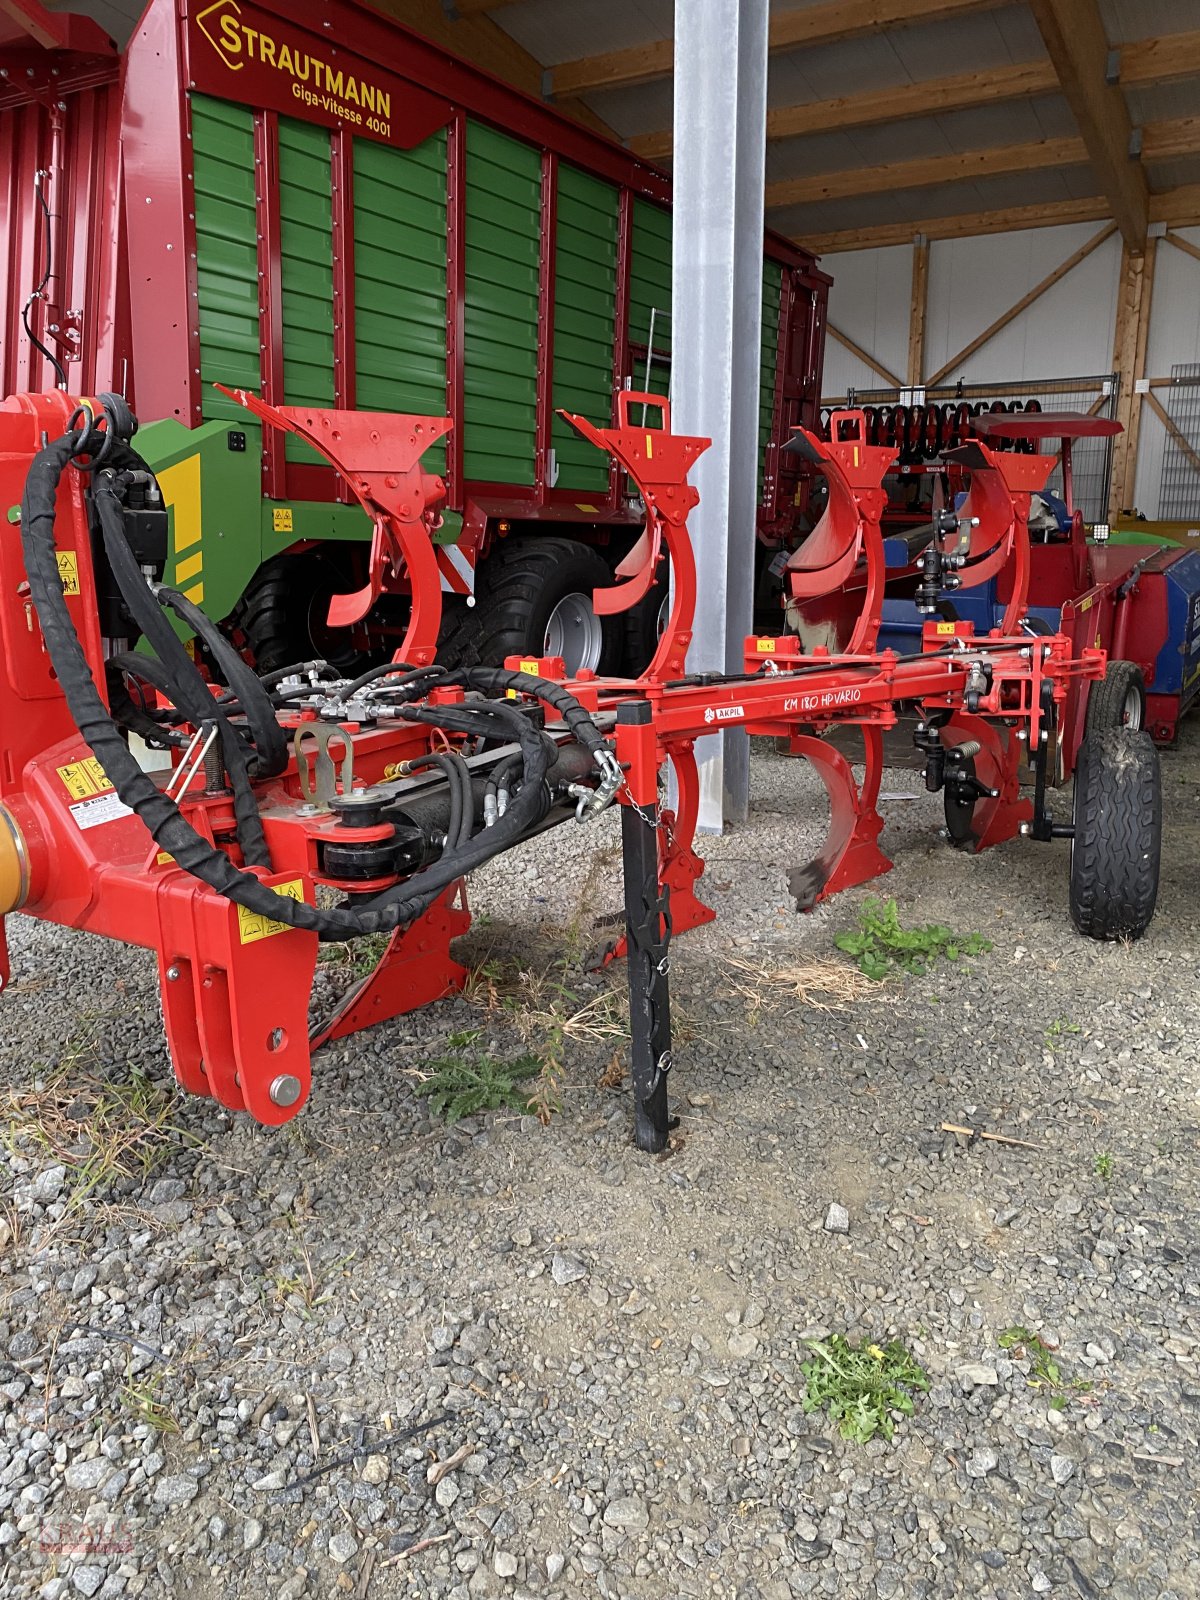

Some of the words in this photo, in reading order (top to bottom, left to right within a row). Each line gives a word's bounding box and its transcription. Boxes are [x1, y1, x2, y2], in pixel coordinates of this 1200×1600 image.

[219, 14, 390, 119] STRAUTMANN
[292, 83, 362, 125] Giga-Vitesse
[366, 116, 391, 138] 4001
[719, 708, 741, 718] AKPIL
[783, 697, 798, 711] KM
